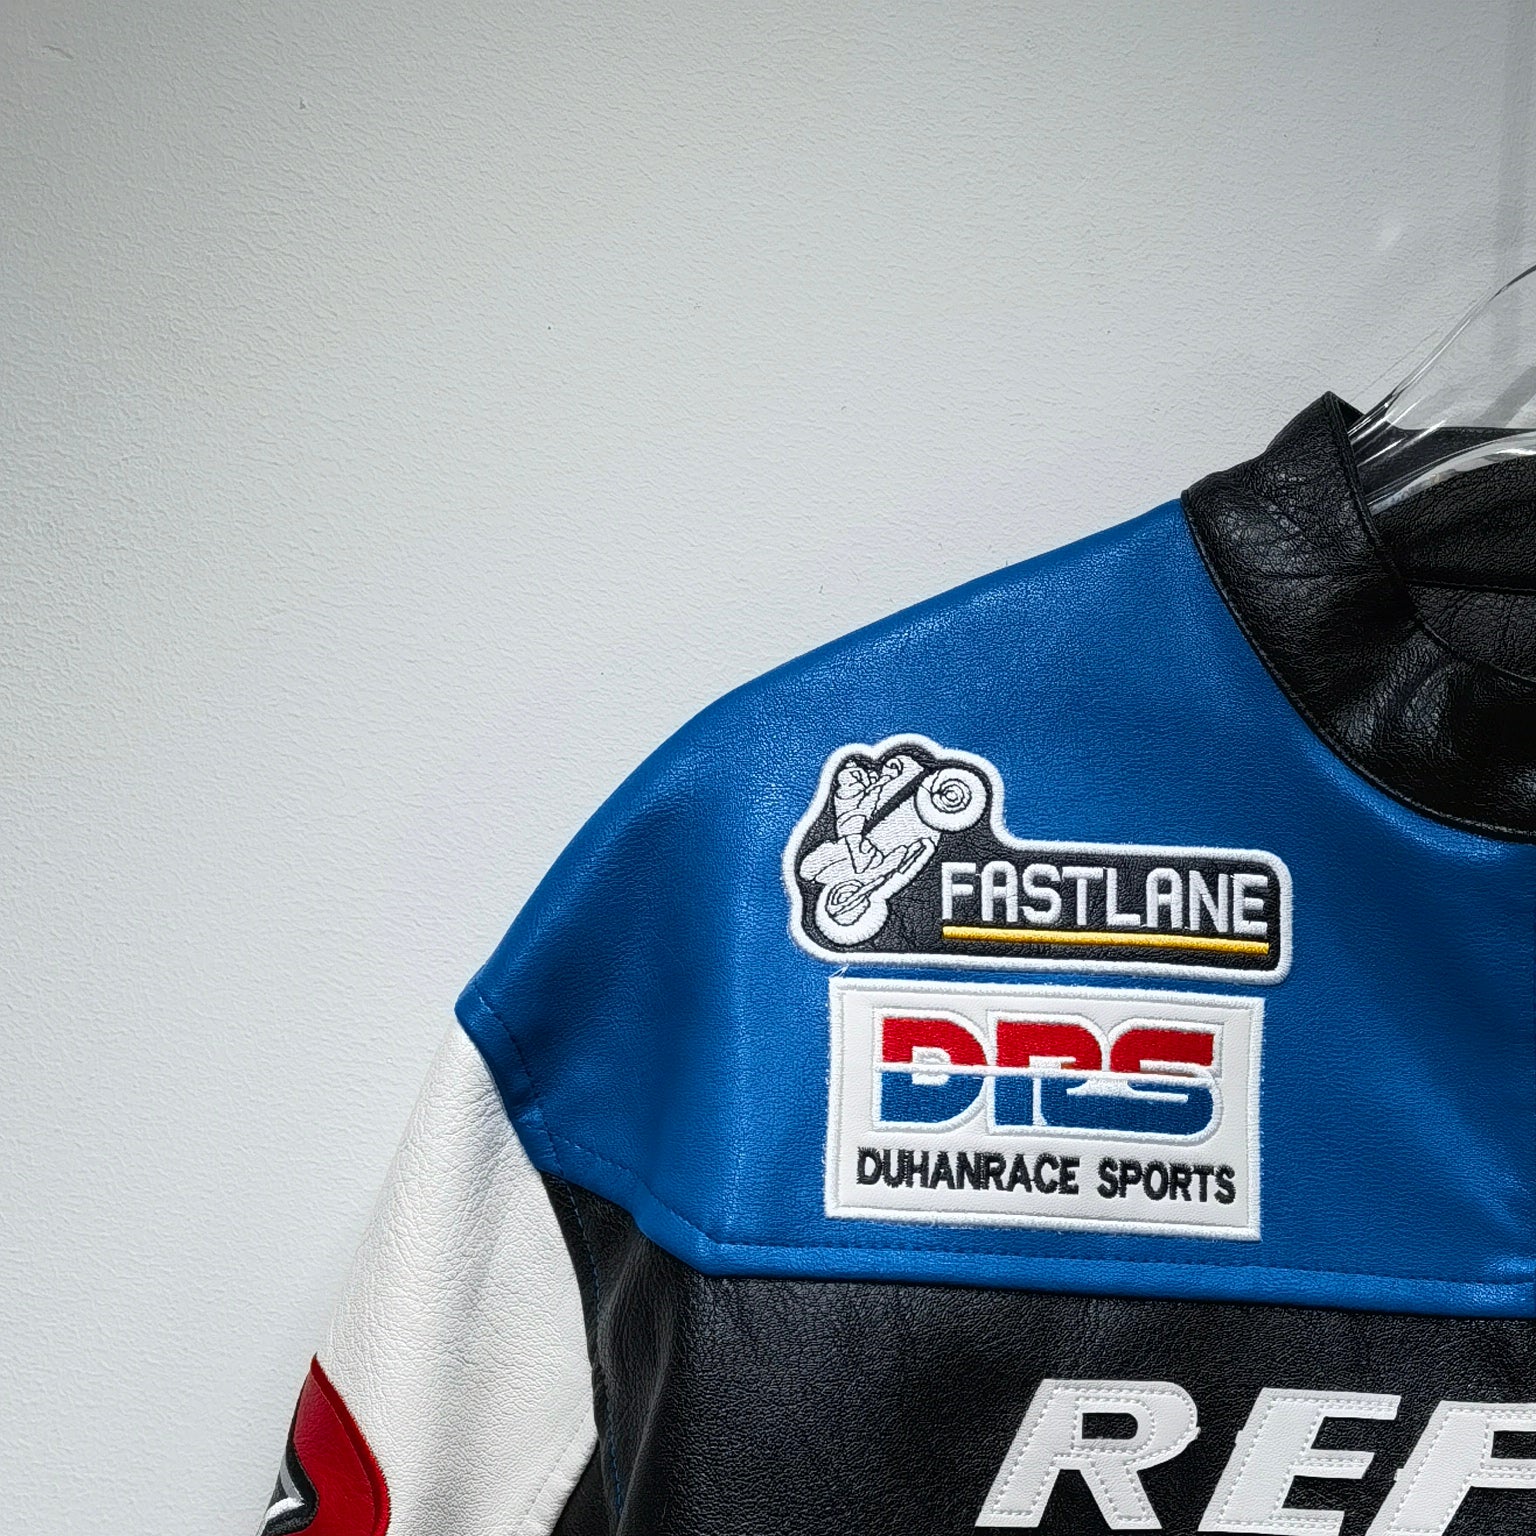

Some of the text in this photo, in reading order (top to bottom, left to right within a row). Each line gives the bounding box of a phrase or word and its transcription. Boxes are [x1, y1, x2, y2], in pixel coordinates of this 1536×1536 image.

[942, 861, 1269, 933] FASTLANE
[874, 1009, 1221, 1143] DRS
[857, 1146, 1236, 1204] DUHANRACE SPORTS
